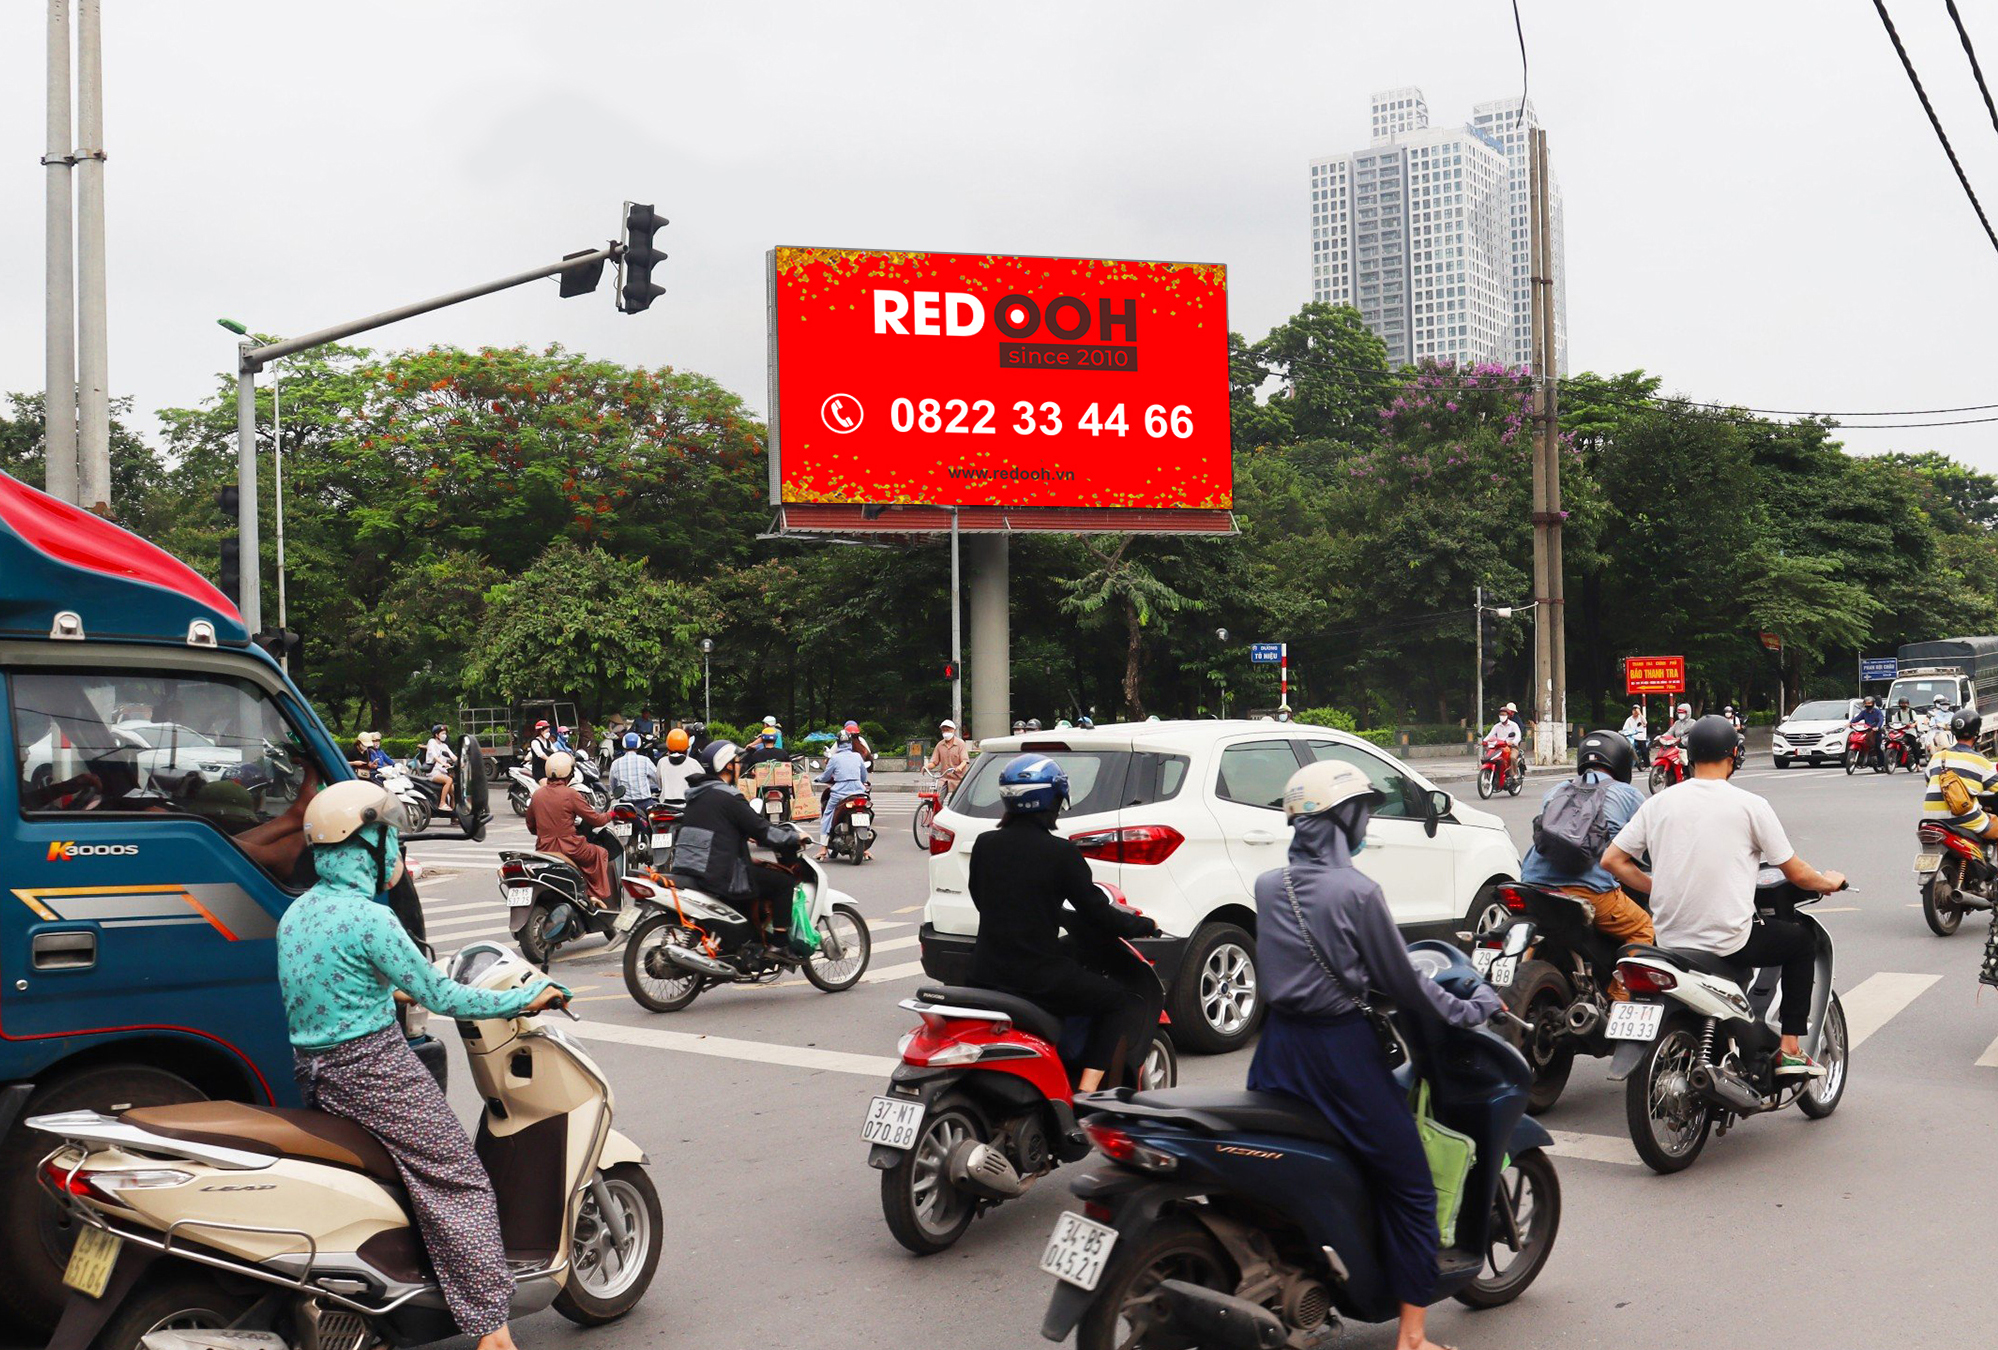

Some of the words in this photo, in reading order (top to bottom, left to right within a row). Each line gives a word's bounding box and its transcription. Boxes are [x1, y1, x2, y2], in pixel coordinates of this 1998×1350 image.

[874, 289, 985, 336] RED
[994, 293, 1138, 342] OOH
[1008, 346, 1070, 365] since
[1076, 349, 1128, 367] 2010
[890, 397, 996, 434] 0822
[1012, 400, 1063, 436] 33
[1078, 402, 1130, 437] 44
[1144, 404, 1194, 439] 66
[947, 466, 1075, 481] www.redooh.vn
[1644, 668, 1665, 679] THANH
[1666, 668, 1679, 678] TRA
[46, 841, 139, 862] K3000S
[1610, 1022, 1655, 1038] 919.33
[874, 1101, 915, 1125] 37-N1
[864, 1120, 913, 1145] 070.88
[1216, 1144, 1284, 1159] VISION
[199, 1183, 277, 1192] LEAD
